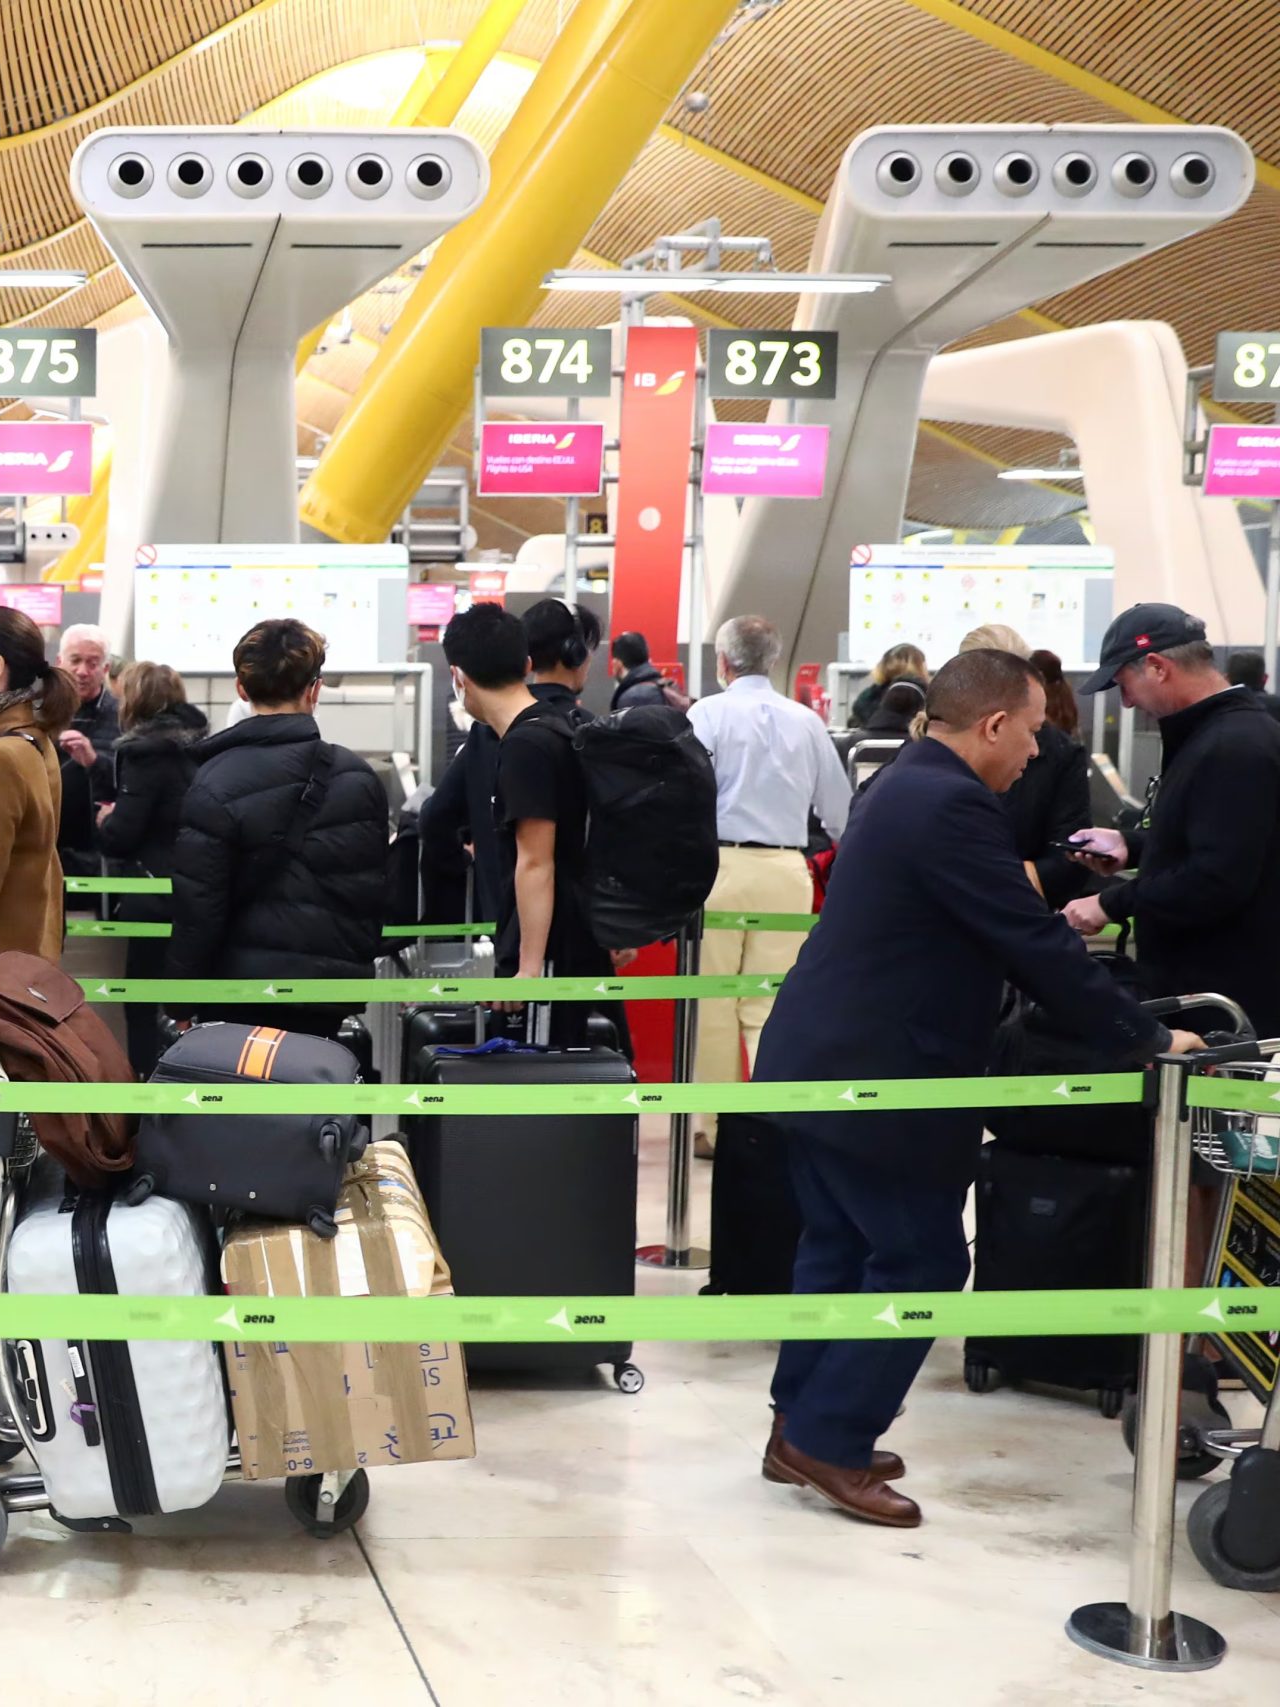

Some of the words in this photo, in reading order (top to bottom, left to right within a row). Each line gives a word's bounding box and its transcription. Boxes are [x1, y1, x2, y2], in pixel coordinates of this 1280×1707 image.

[500, 338, 593, 384] 874
[724, 339, 821, 387] 873
[634, 372, 656, 387] IB
[508, 433, 556, 444] IBERIA
[1071, 1085, 1092, 1093] aena
[857, 1091, 878, 1099] aena
[901, 1310, 933, 1320] aena
[1226, 1305, 1258, 1315] aena
[243, 1314, 276, 1324] aena
[574, 1315, 606, 1325] aena
